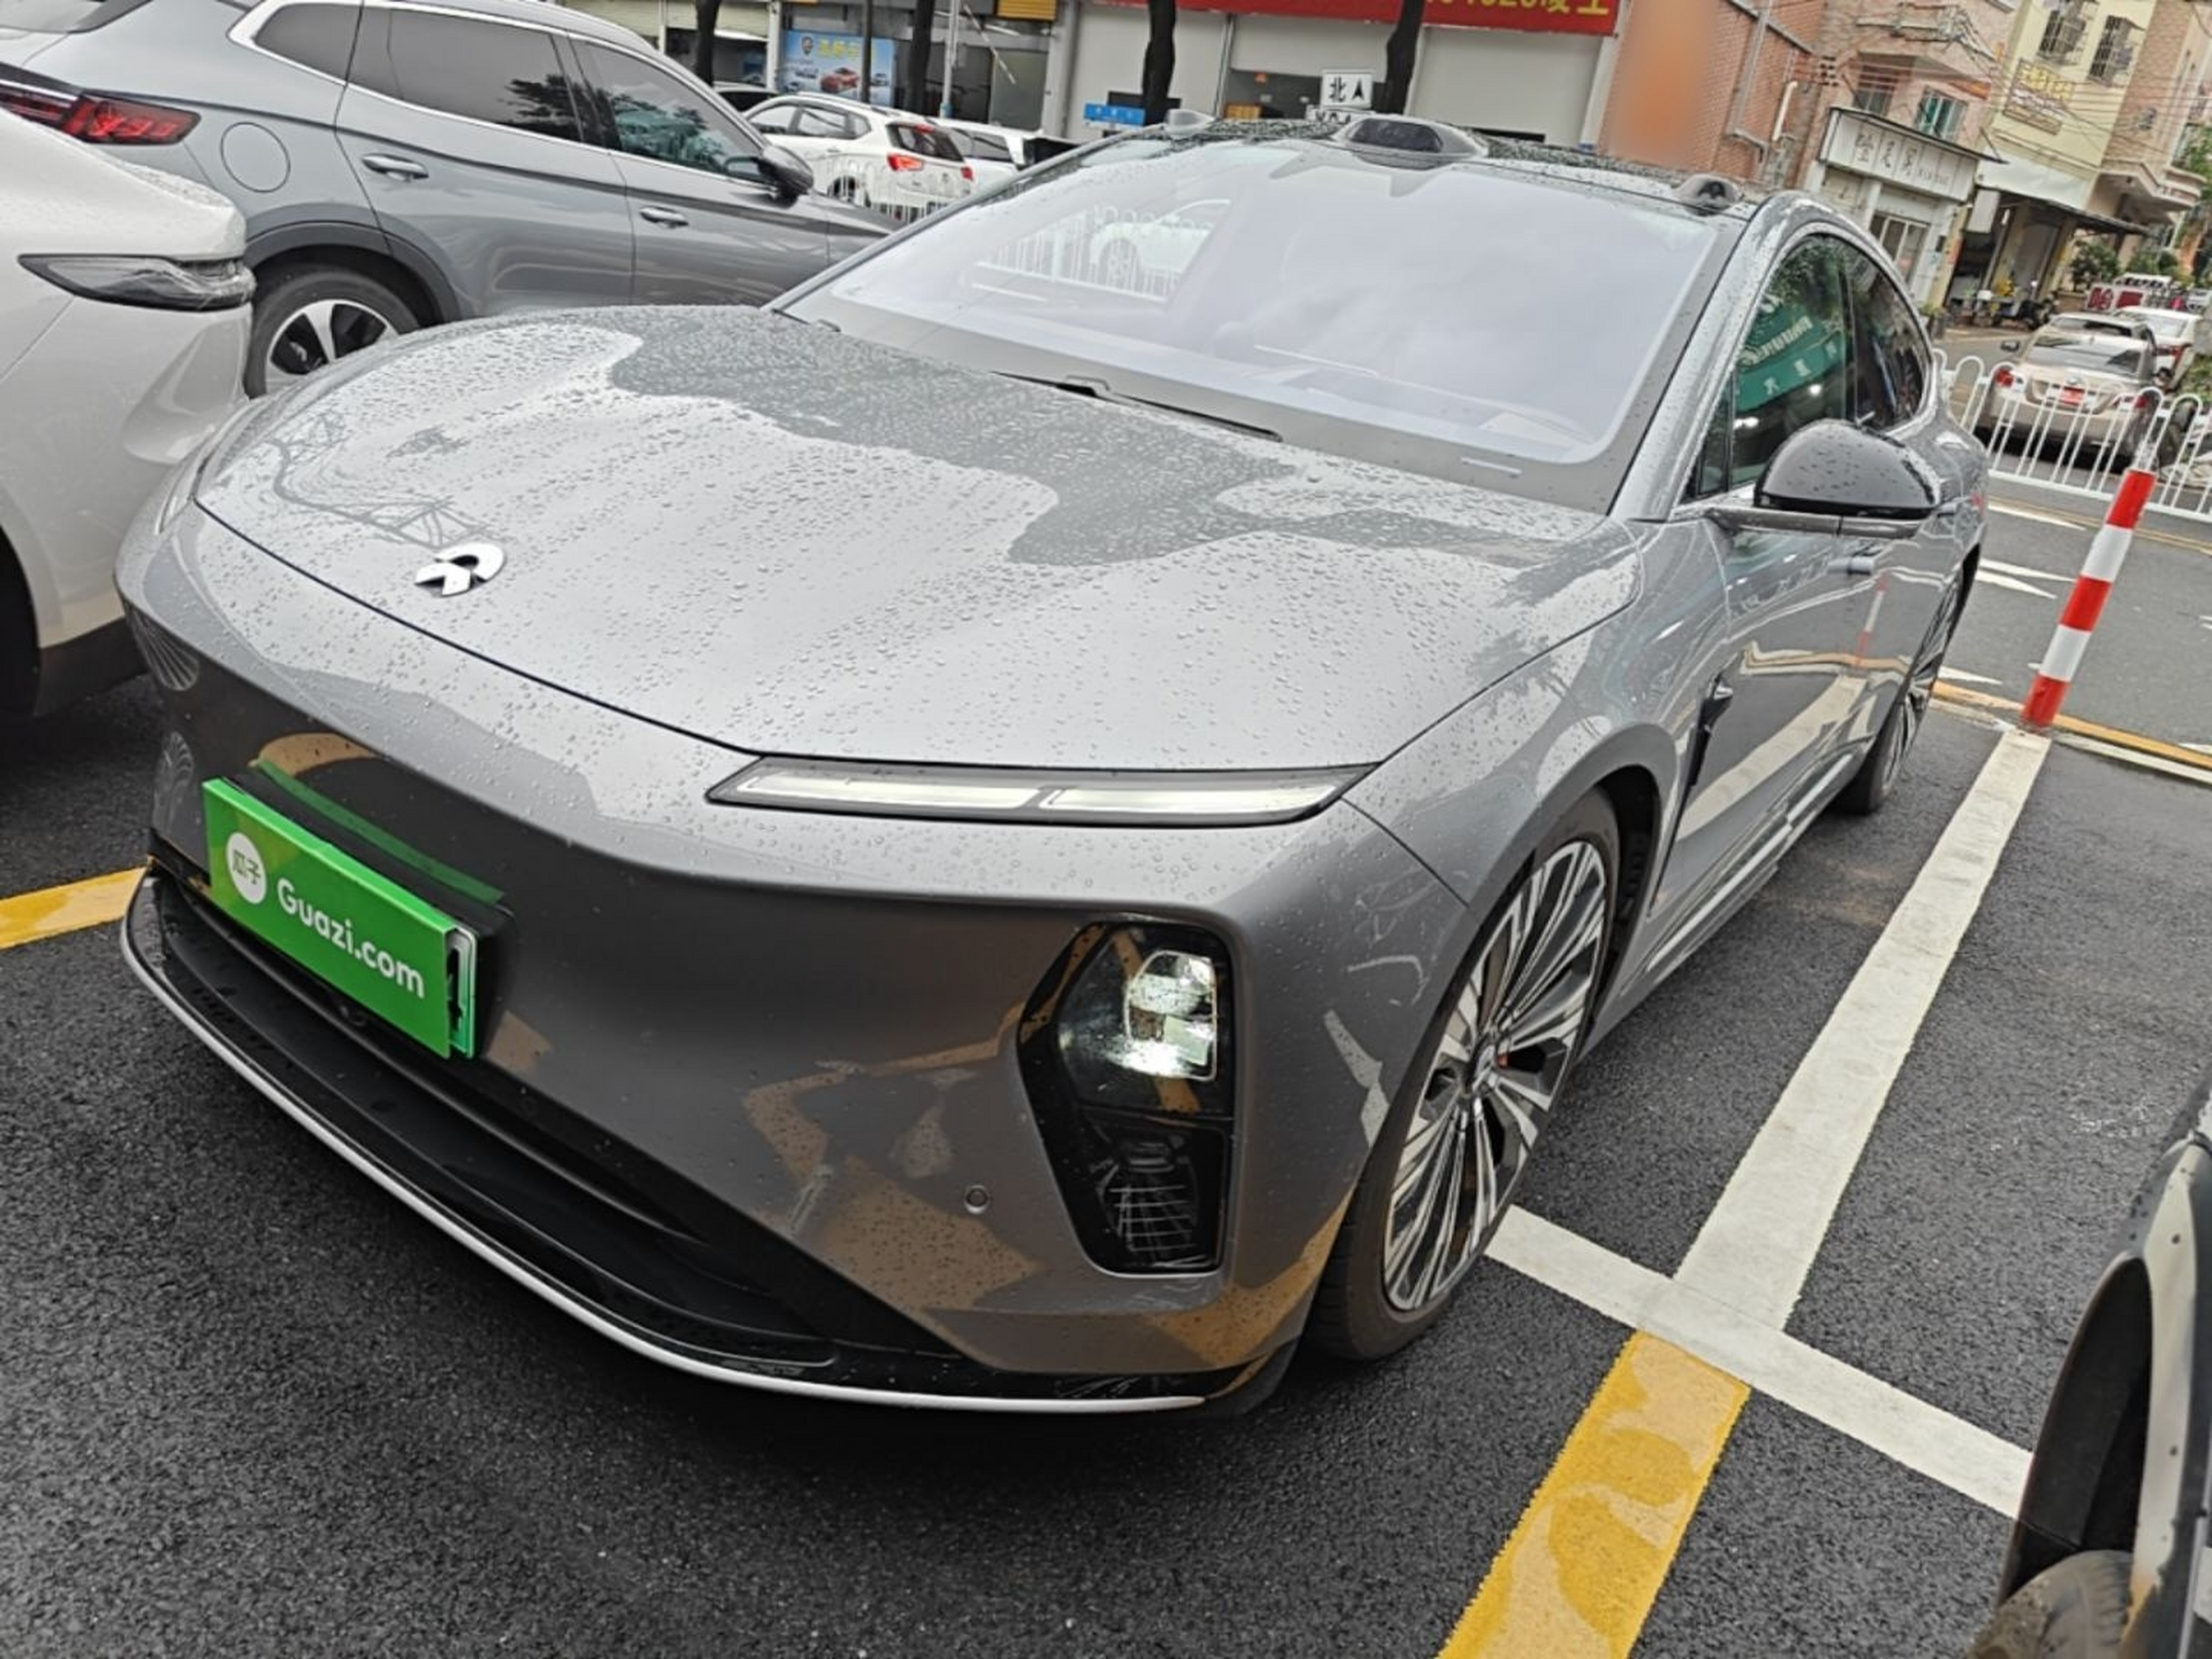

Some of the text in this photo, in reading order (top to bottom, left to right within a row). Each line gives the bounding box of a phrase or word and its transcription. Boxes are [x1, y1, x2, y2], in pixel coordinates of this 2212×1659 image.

[1328, 77, 1347, 103] 北
[233, 849, 262, 885] 瓜子
[277, 877, 425, 999] Guazi.com
